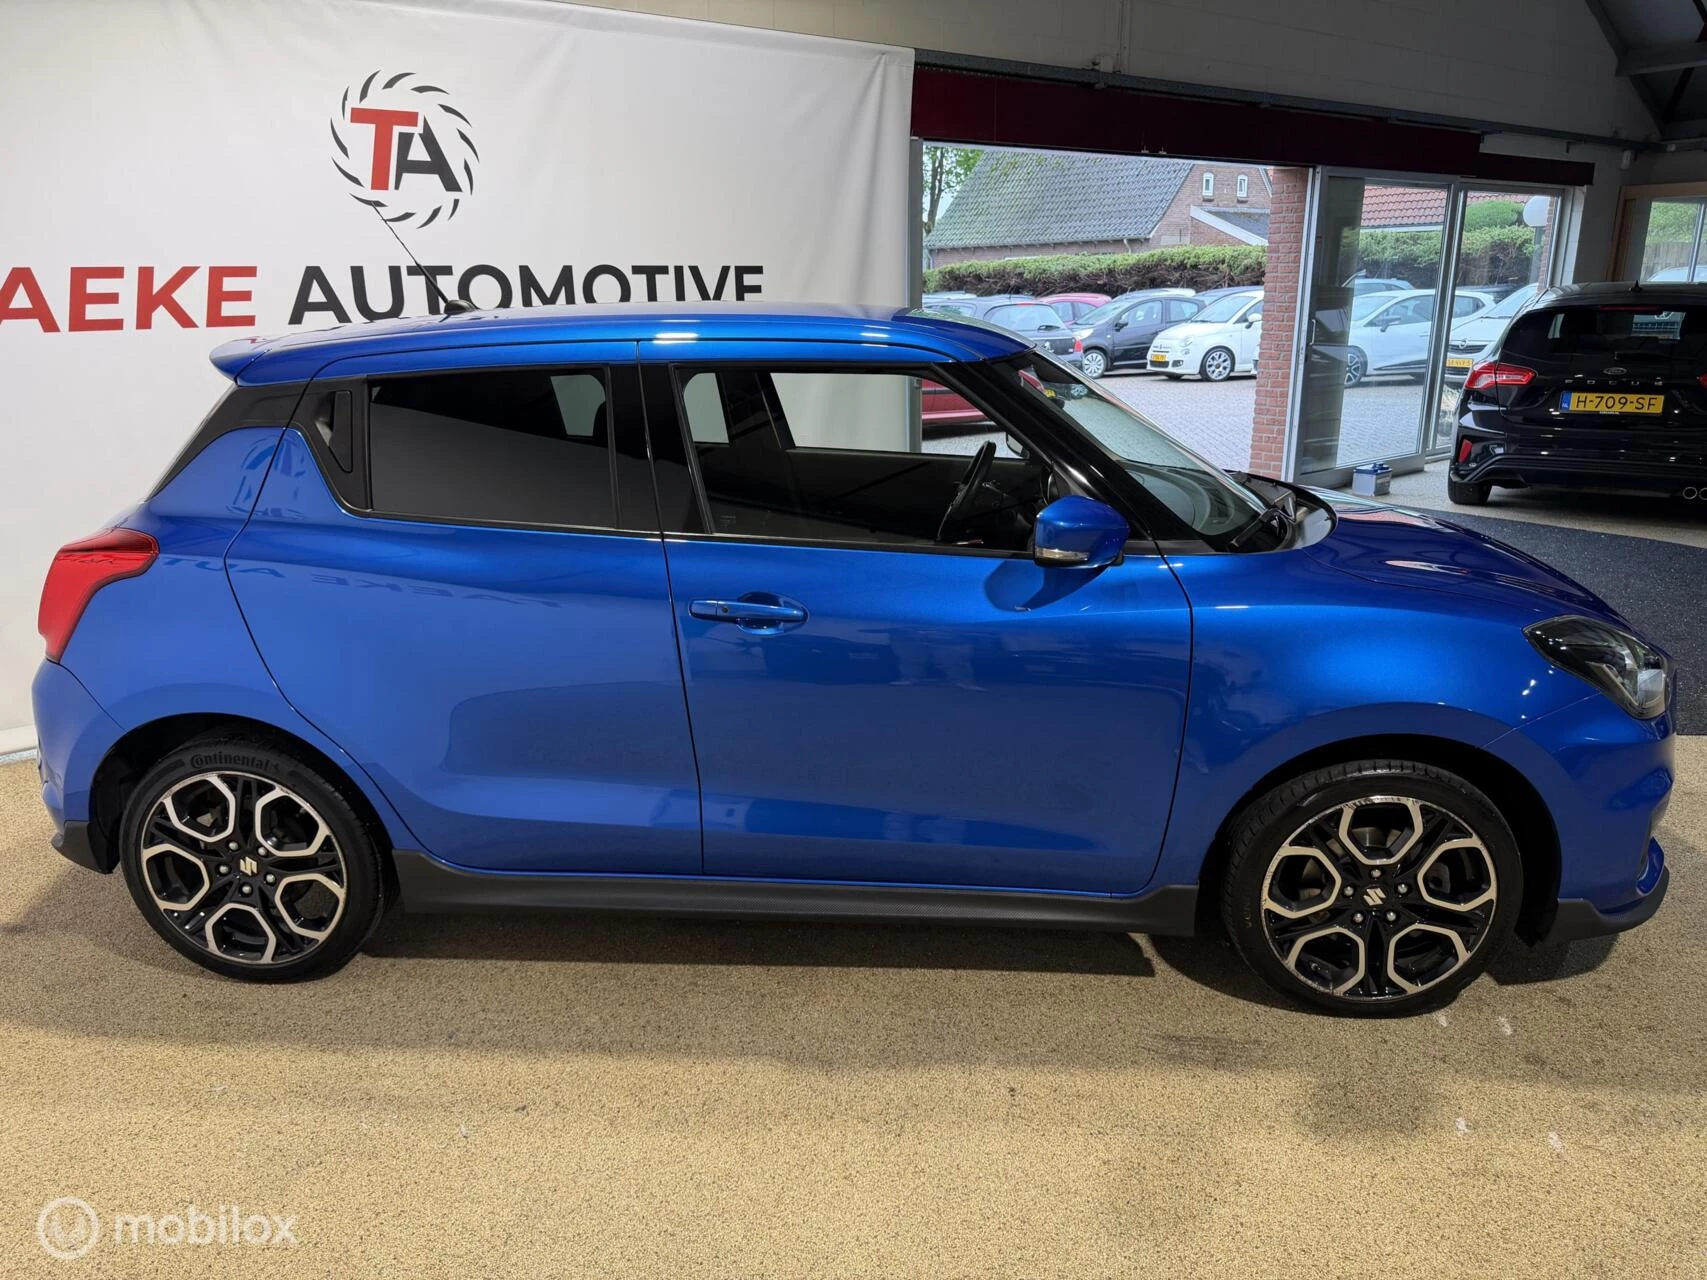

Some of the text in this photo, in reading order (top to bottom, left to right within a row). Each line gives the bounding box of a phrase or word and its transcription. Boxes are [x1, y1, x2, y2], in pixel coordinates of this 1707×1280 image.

[350, 107, 463, 192] TA
[0, 266, 257, 333] AEKE
[1576, 395, 1658, 410] H-709-SF
[190, 752, 270, 771] Continental
